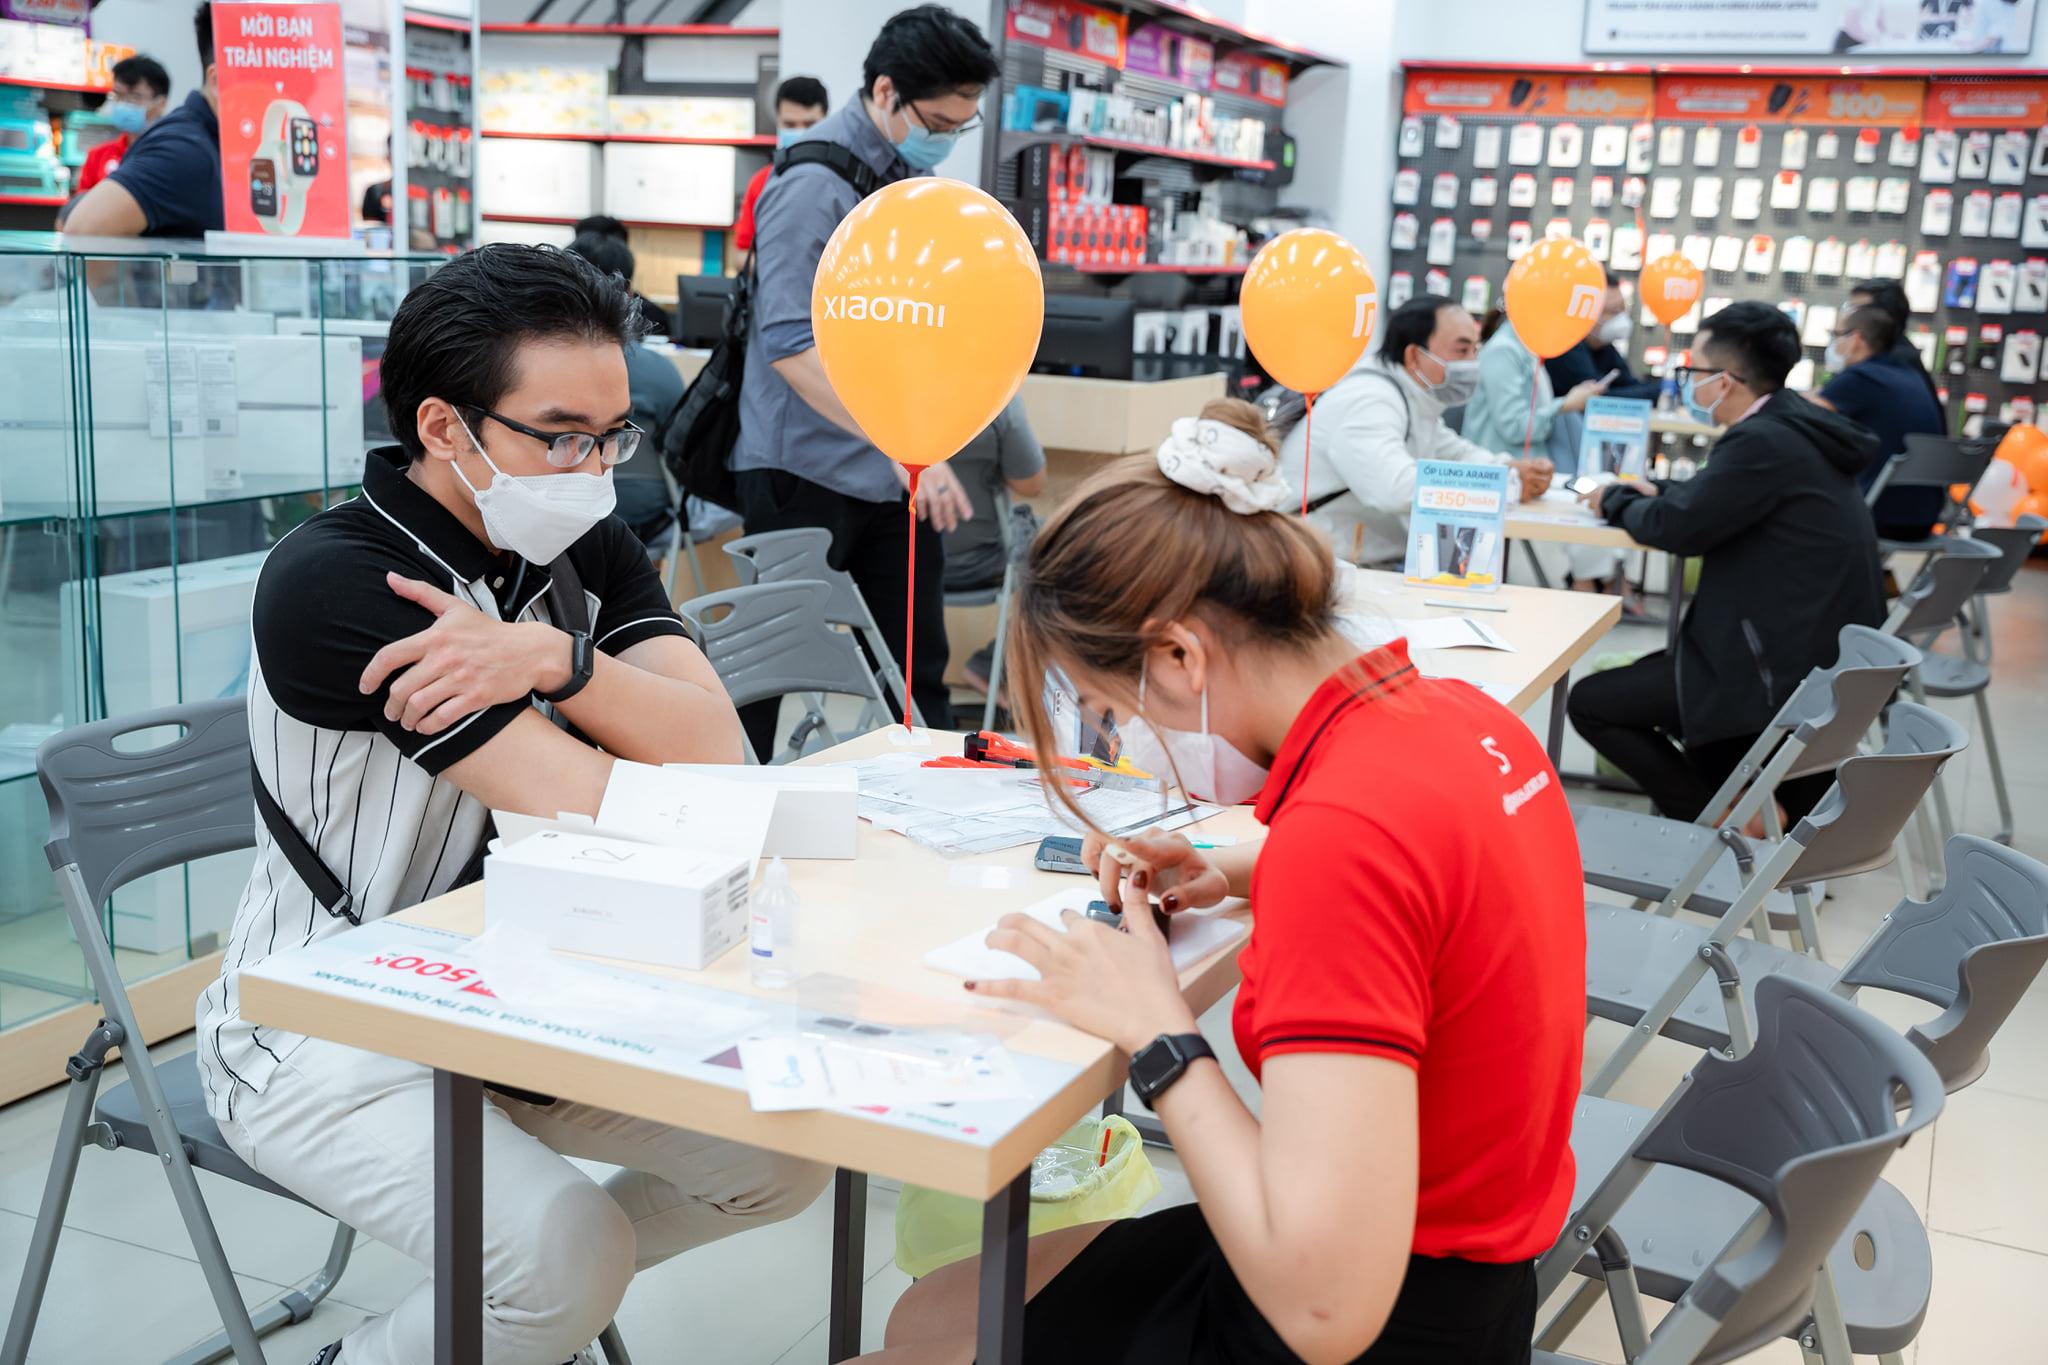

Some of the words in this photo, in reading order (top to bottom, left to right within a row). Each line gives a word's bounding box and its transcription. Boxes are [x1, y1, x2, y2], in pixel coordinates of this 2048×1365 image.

[241, 11, 273, 37] MỜI
[276, 16, 313, 42] BẠN
[224, 41, 263, 68] TRẢI
[265, 43, 333, 73] NGHIỆM
[1466, 471, 1500, 481] ARAREE
